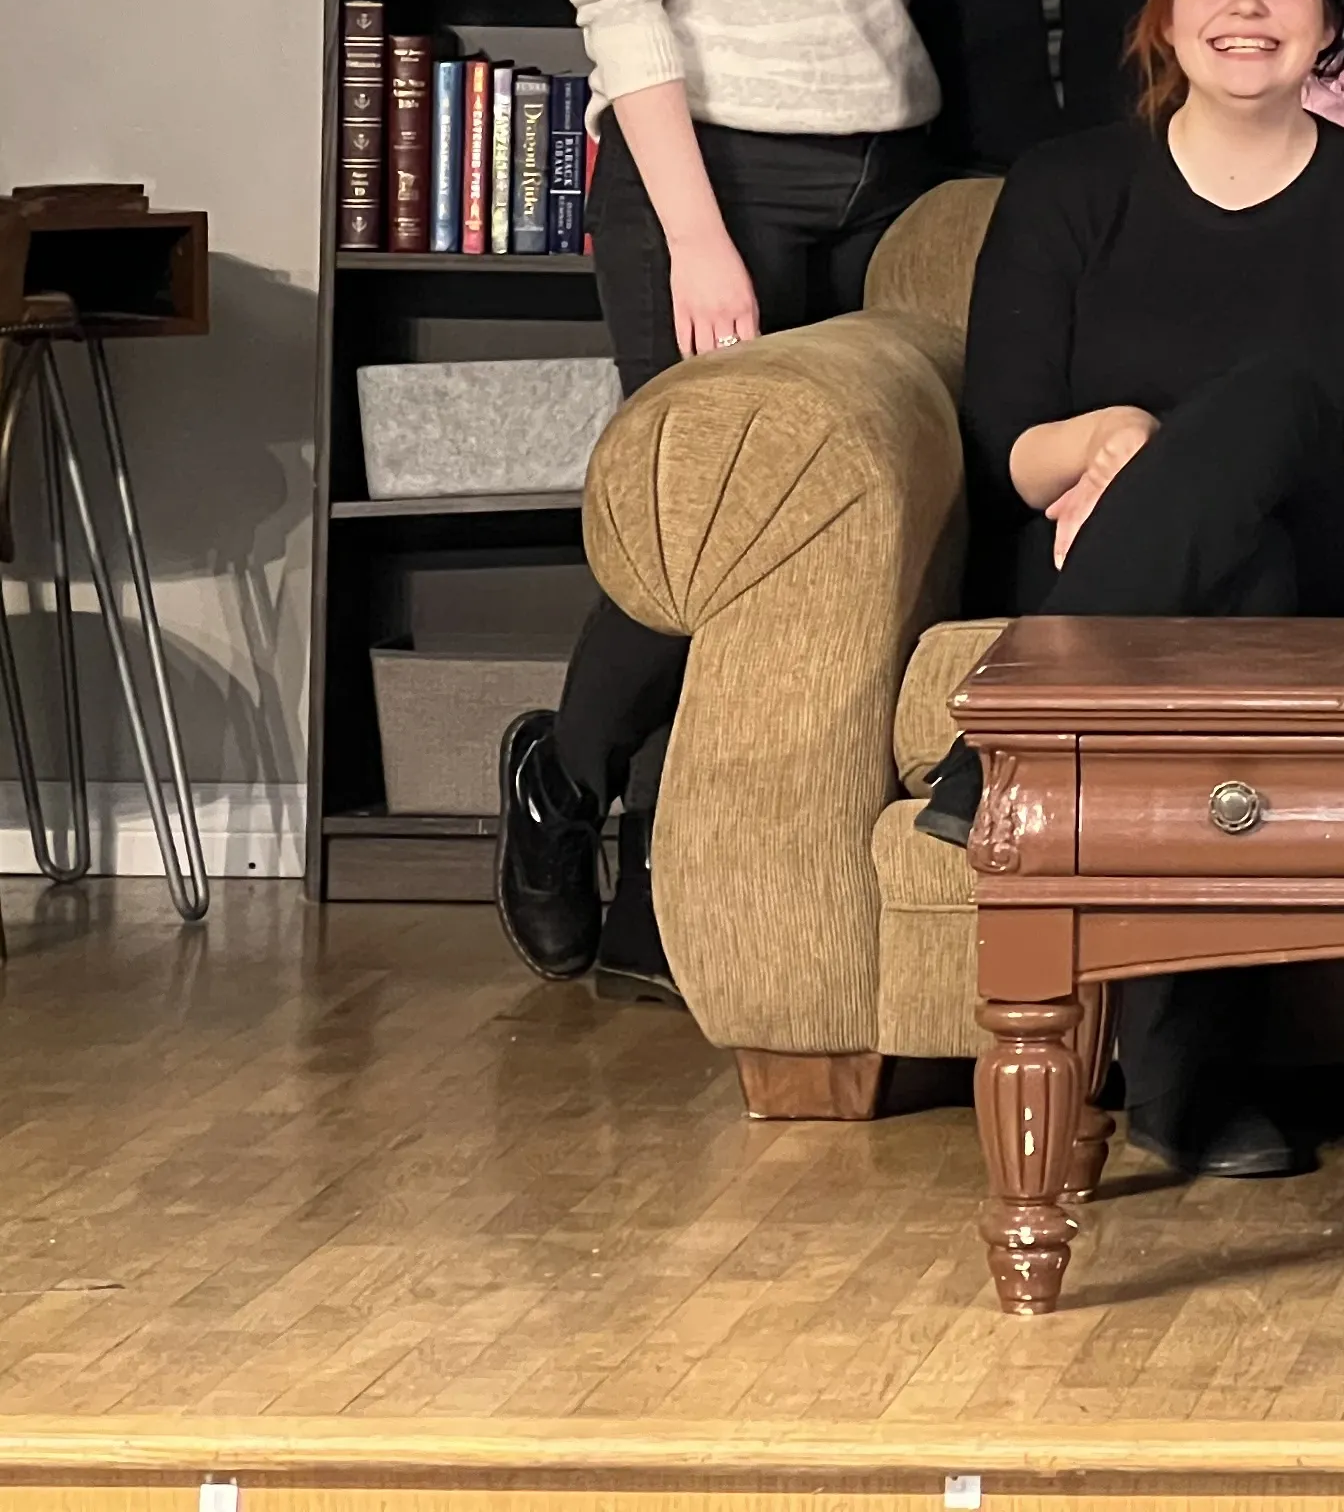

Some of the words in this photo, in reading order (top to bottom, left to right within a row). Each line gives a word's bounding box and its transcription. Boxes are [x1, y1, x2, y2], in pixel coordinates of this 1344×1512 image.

[523, 103, 544, 168] Dragon
[554, 140, 564, 183] OBAMA
[564, 138, 574, 186] BARACK
[520, 171, 542, 215] Rider
